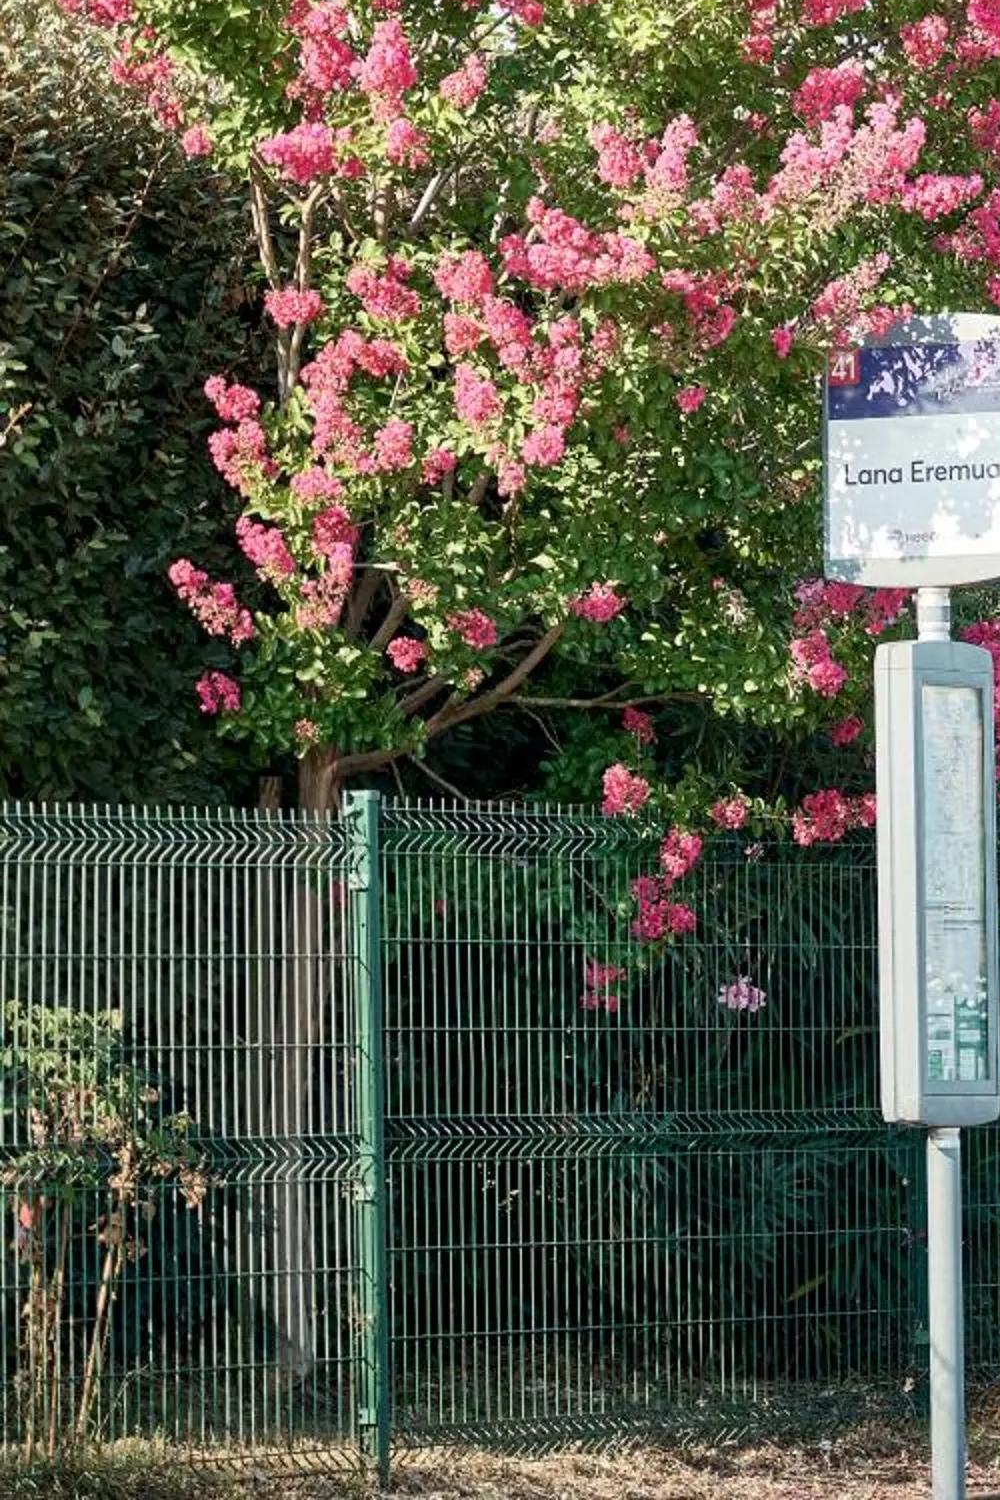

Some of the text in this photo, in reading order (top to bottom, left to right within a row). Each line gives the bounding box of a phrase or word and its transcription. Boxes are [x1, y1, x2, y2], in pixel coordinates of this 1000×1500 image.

[831, 353, 857, 380] 41
[845, 461, 1000, 485] Lana Eremua
